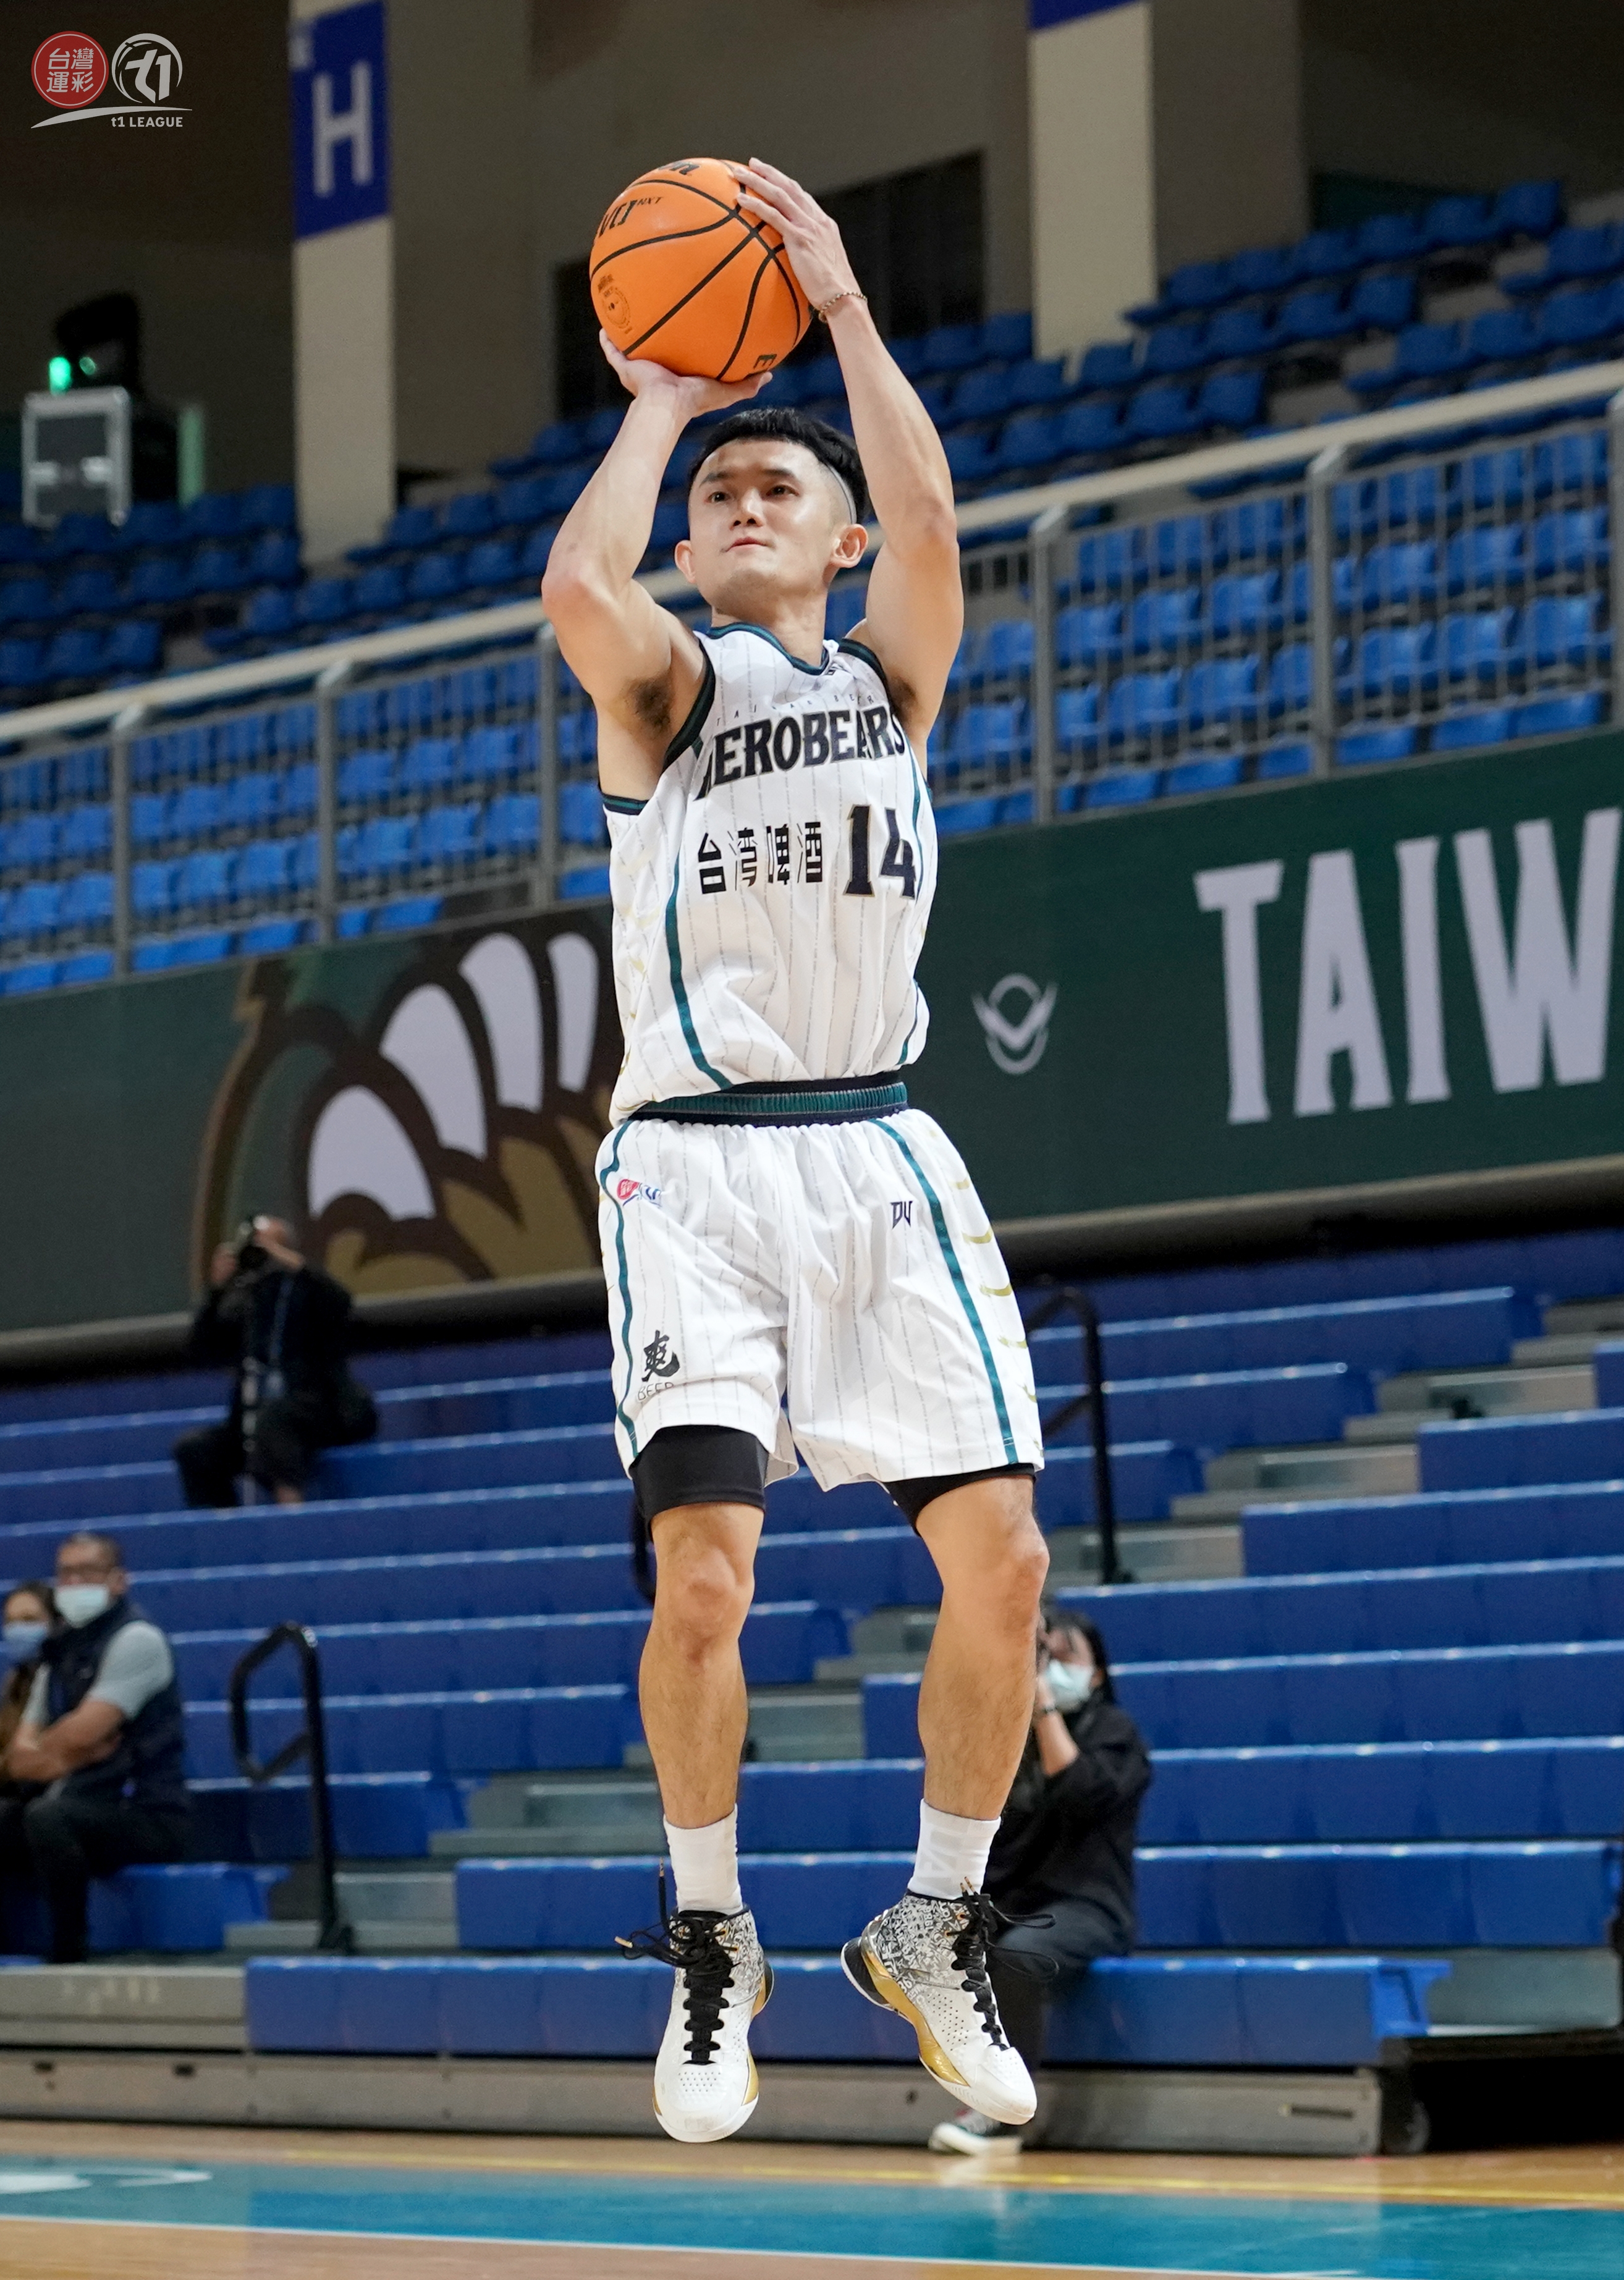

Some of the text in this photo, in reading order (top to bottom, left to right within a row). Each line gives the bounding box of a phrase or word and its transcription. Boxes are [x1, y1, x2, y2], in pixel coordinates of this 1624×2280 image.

[313, 60, 373, 197] H
[637, 196, 663, 206] NXT
[843, 804, 916, 900] 14
[1193, 806, 1622, 1124] TAIW
